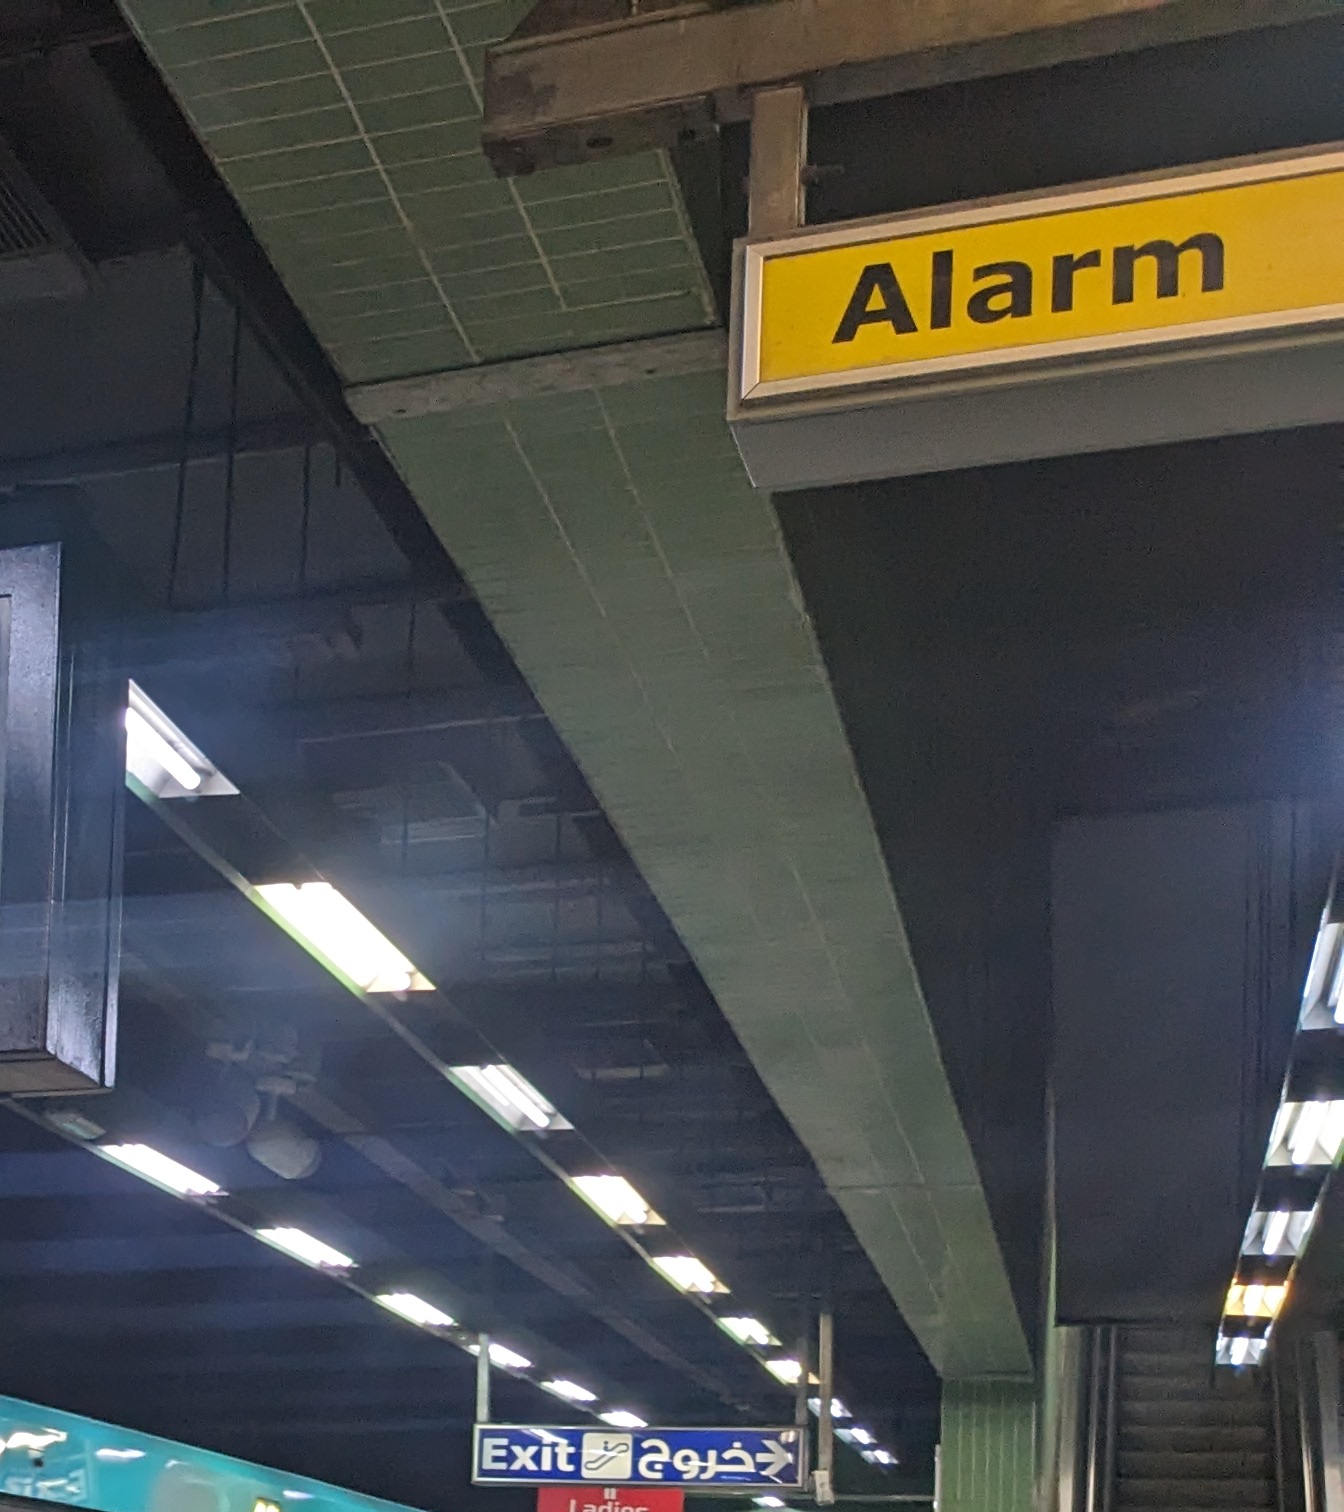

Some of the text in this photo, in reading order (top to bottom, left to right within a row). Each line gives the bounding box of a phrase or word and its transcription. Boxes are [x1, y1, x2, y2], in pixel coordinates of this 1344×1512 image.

[831, 232, 1226, 345] Alarm
[482, 1437, 576, 1472] Exit
[638, 1439, 756, 1480] خروج
